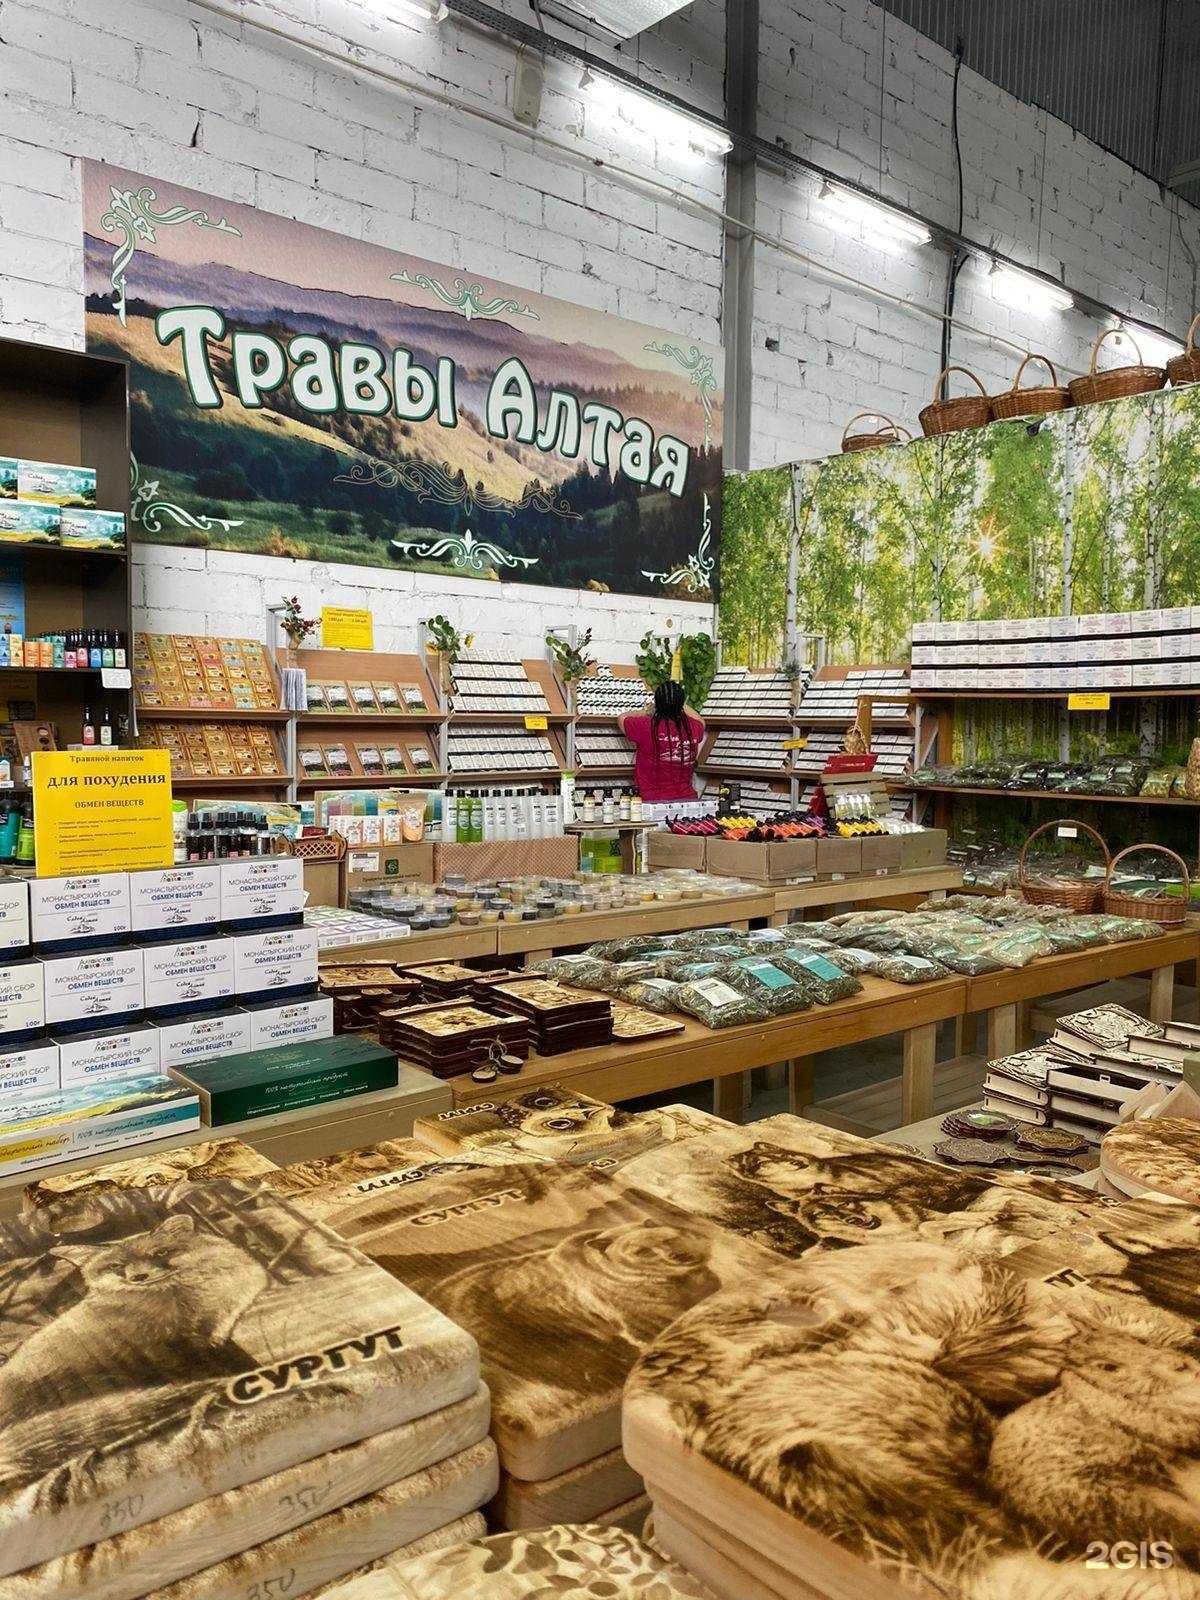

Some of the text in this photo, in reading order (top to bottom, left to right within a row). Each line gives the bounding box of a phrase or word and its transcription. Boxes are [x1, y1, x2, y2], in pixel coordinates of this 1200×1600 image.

[154, 306, 691, 497] Травы Алтая
[69, 755, 110, 763] Травяной
[47, 774, 166, 788] для похудения
[106, 799, 145, 807] ВЕЩЕСТВ
[228, 875, 279, 887] МОНАСТЫРСКИЙ
[261, 882, 287, 890] ВЕЩЕСТВ
[42, 889, 122, 903] МОНАСТЫРСКИЙ СБОР
[140, 883, 194, 895] МОНАСТЫРСКИЙ
[150, 890, 203, 901] ОБМЕН ВЕЩЕСТВ
[54, 899, 111, 910] ОБМЕН ВЕЩЕСТВ
[243, 943, 311, 958] МОНАСТЫРСКИЙ СБОР
[153, 954, 227, 970] МОНАСТЫРСКИЙ СБОР
[254, 952, 302, 964] ОБМЕН ВЕЩЕСТВ
[54, 967, 136, 984] МОНАСТЫРСКИЙ СБОР
[165, 964, 216, 976] ОБМЕН ВЕЩЕСТВ
[14, 982, 35, 992] СБОР
[67, 977, 125, 991] ОБМЕН ВЕЩЕСТВ
[259, 1015, 328, 1033] МОНАСТЫРСКИЙ СБОР
[270, 1024, 317, 1038] ОБМЕН ВЕЩЕСТВ
[169, 1031, 243, 1048] МОНАСТЫРСКИЙ СБОР
[181, 1040, 233, 1055] ОБМЕН ВЕЩЕСТВ
[71, 1046, 153, 1067] МОНАСТЫРСКИЙ СБОР
[28, 1066, 50, 1075] СБОР
[84, 1057, 141, 1073] ОБМЕН ВЕЩЕСТВ
[3, 1077, 38, 1089] ВЕЩЕСТВ
[229, 1325, 403, 1402] СУРГУТ
